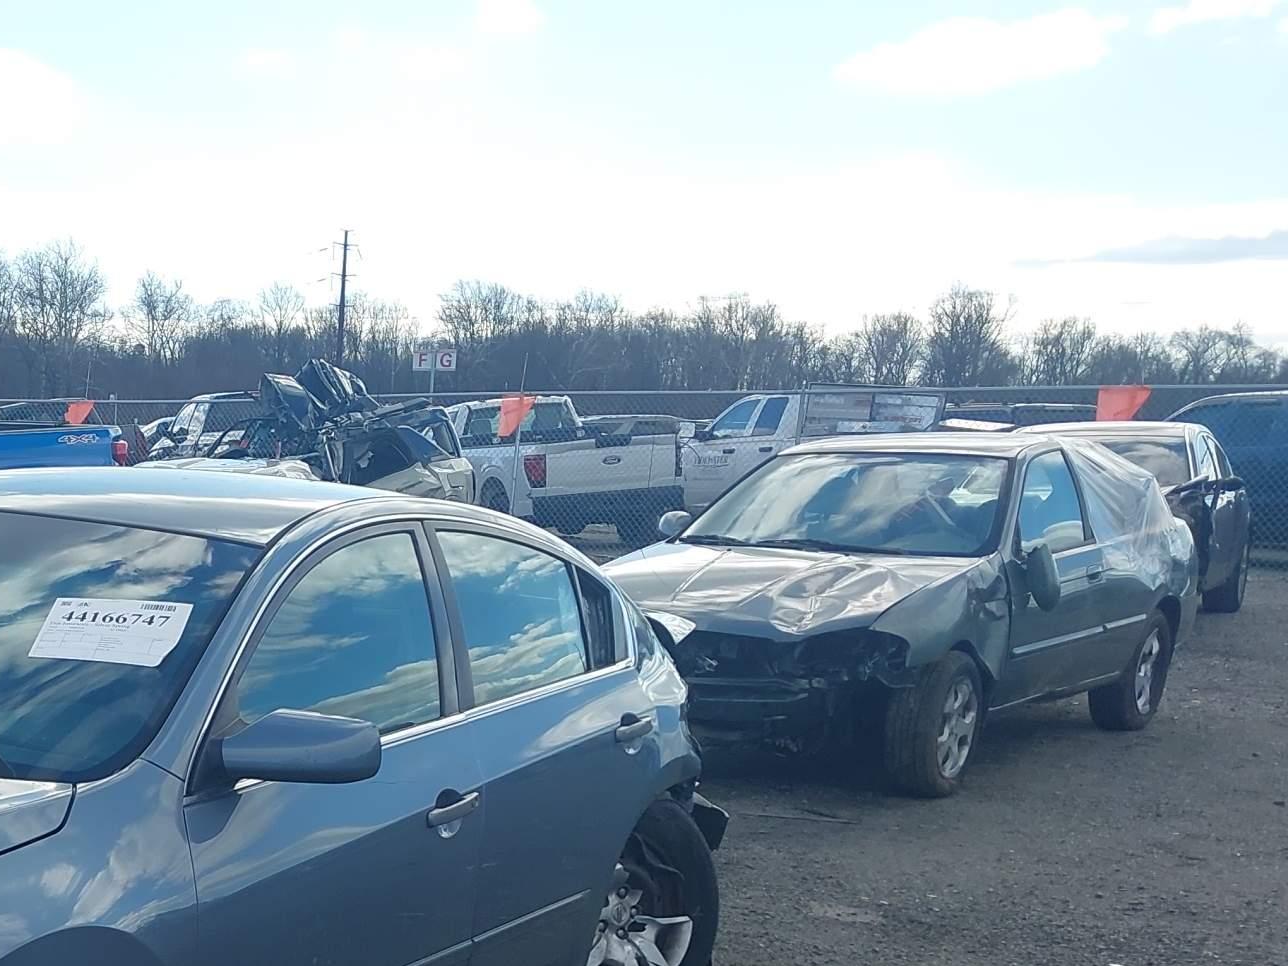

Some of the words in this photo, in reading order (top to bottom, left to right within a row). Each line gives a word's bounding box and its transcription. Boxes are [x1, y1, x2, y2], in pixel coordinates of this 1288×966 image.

[418, 352, 429, 368] F
[440, 352, 453, 368] G
[61, 610, 172, 628] 44166747
